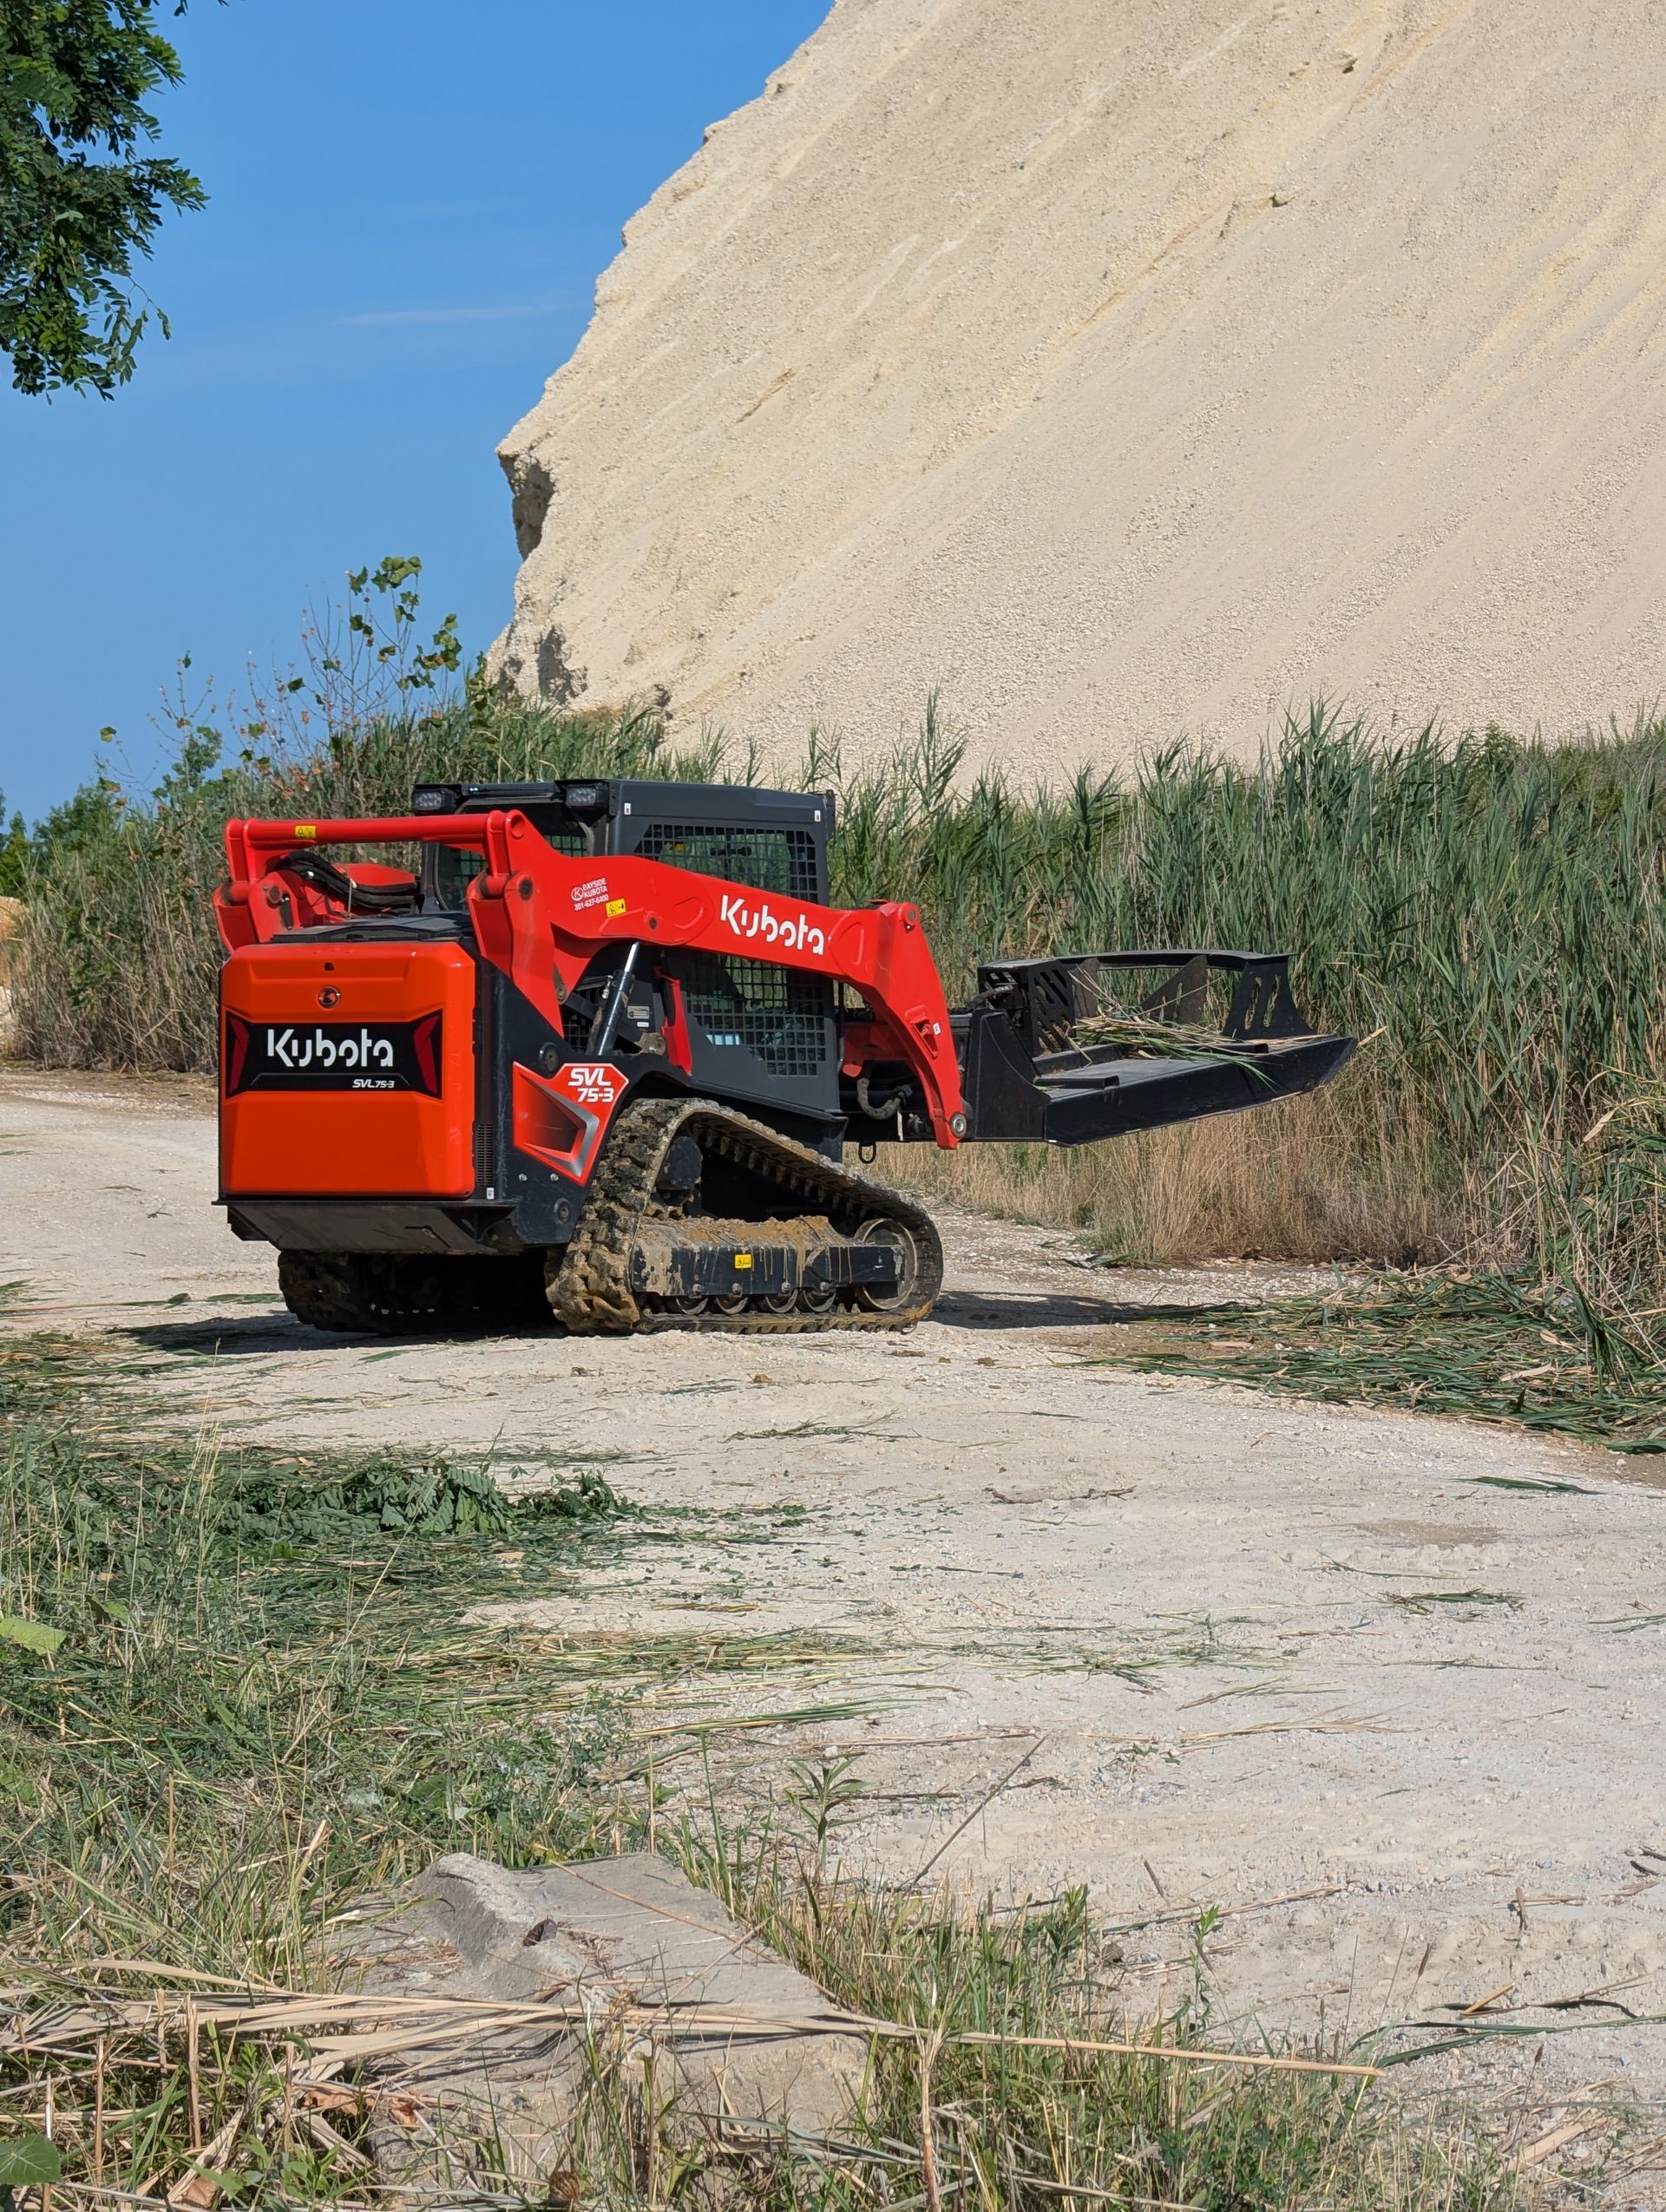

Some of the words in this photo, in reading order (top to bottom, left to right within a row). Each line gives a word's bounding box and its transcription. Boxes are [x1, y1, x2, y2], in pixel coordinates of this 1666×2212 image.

[583, 886, 608, 898] KUBOTA
[720, 894, 824, 955] Kubota
[267, 1029, 394, 1067] Kubota
[567, 1068, 612, 1086] SVL
[577, 1088, 614, 1103] 75-3
